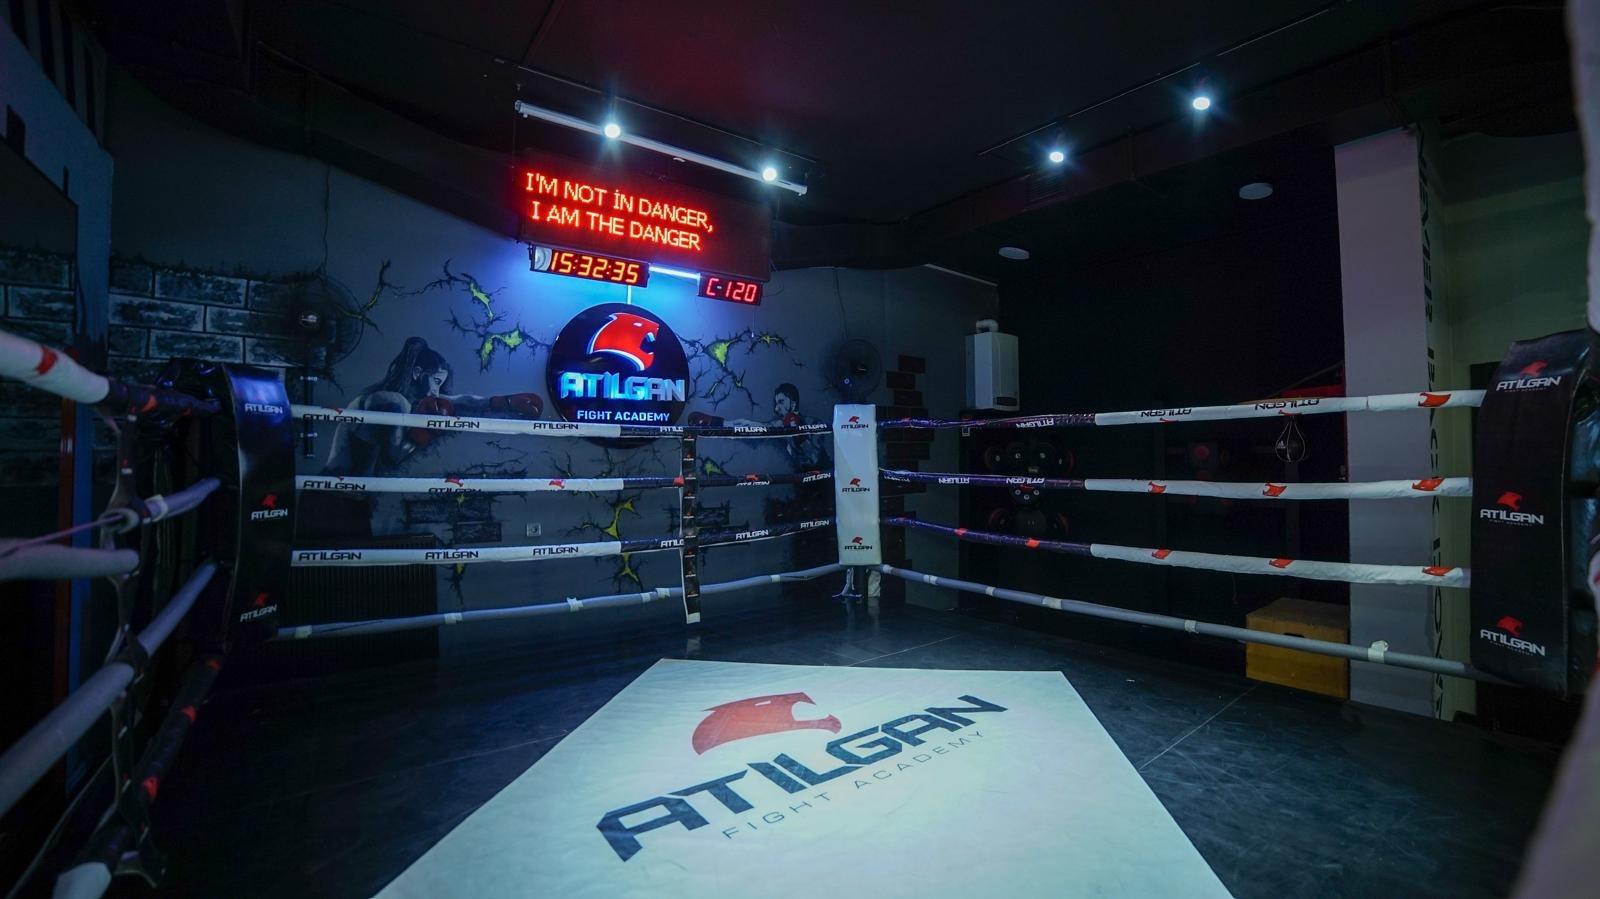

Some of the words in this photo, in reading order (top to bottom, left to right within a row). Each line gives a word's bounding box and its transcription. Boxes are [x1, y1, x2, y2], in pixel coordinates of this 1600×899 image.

[525, 172, 558, 196] I'M
[564, 185, 607, 207] NOT
[639, 198, 714, 232] DANGER,
[531, 201, 540, 220] I
[547, 206, 579, 228] AM
[586, 211, 624, 236] THE
[630, 221, 701, 251] DANGER
[550, 252, 640, 283] 15:32:35
[561, 371, 685, 402] ATILGAN
[1495, 376, 1562, 391] ATILGAN
[245, 403, 283, 414] ATILGAN
[577, 410, 612, 420] FIGHT
[615, 411, 670, 422] ACADEMY
[427, 420, 480, 429] ATILGAN
[533, 422, 579, 430] ATILGAN
[303, 480, 366, 490] ATILGAN
[251, 508, 288, 520] ATILGAN
[1480, 508, 1544, 526] ATILGAN
[800, 519, 830, 529] ATILGAN
[736, 529, 769, 540] ATILGAN
[299, 551, 362, 561] ATILGAN
[425, 551, 479, 560] ATILGAN
[533, 546, 579, 556] ATILGAN
[240, 603, 278, 622] ATILGAN
[1480, 628, 1546, 657] ATILGAN
[597, 694, 1008, 862] ATILGAN
[722, 792, 831, 840] FIGHT
[854, 730, 986, 790] ACADEMY
